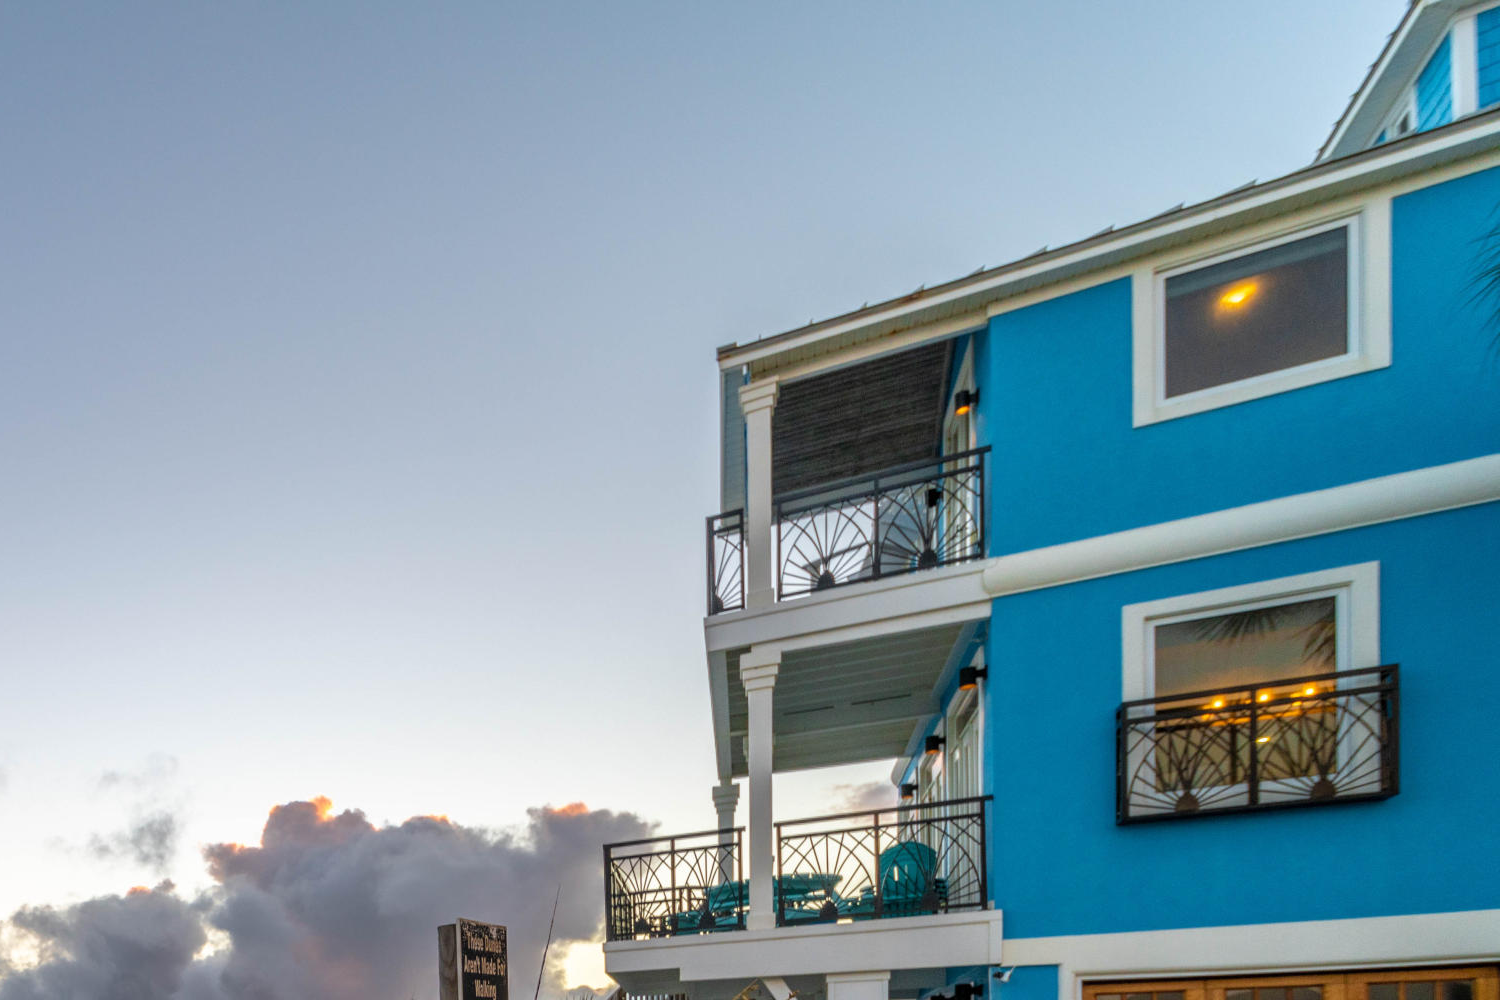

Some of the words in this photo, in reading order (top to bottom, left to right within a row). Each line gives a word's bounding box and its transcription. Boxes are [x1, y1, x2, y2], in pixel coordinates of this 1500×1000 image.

[468, 932, 484, 951] These
[464, 954, 480, 974] Aren't
[481, 957, 497, 975] Made
[497, 958, 506, 976] For
